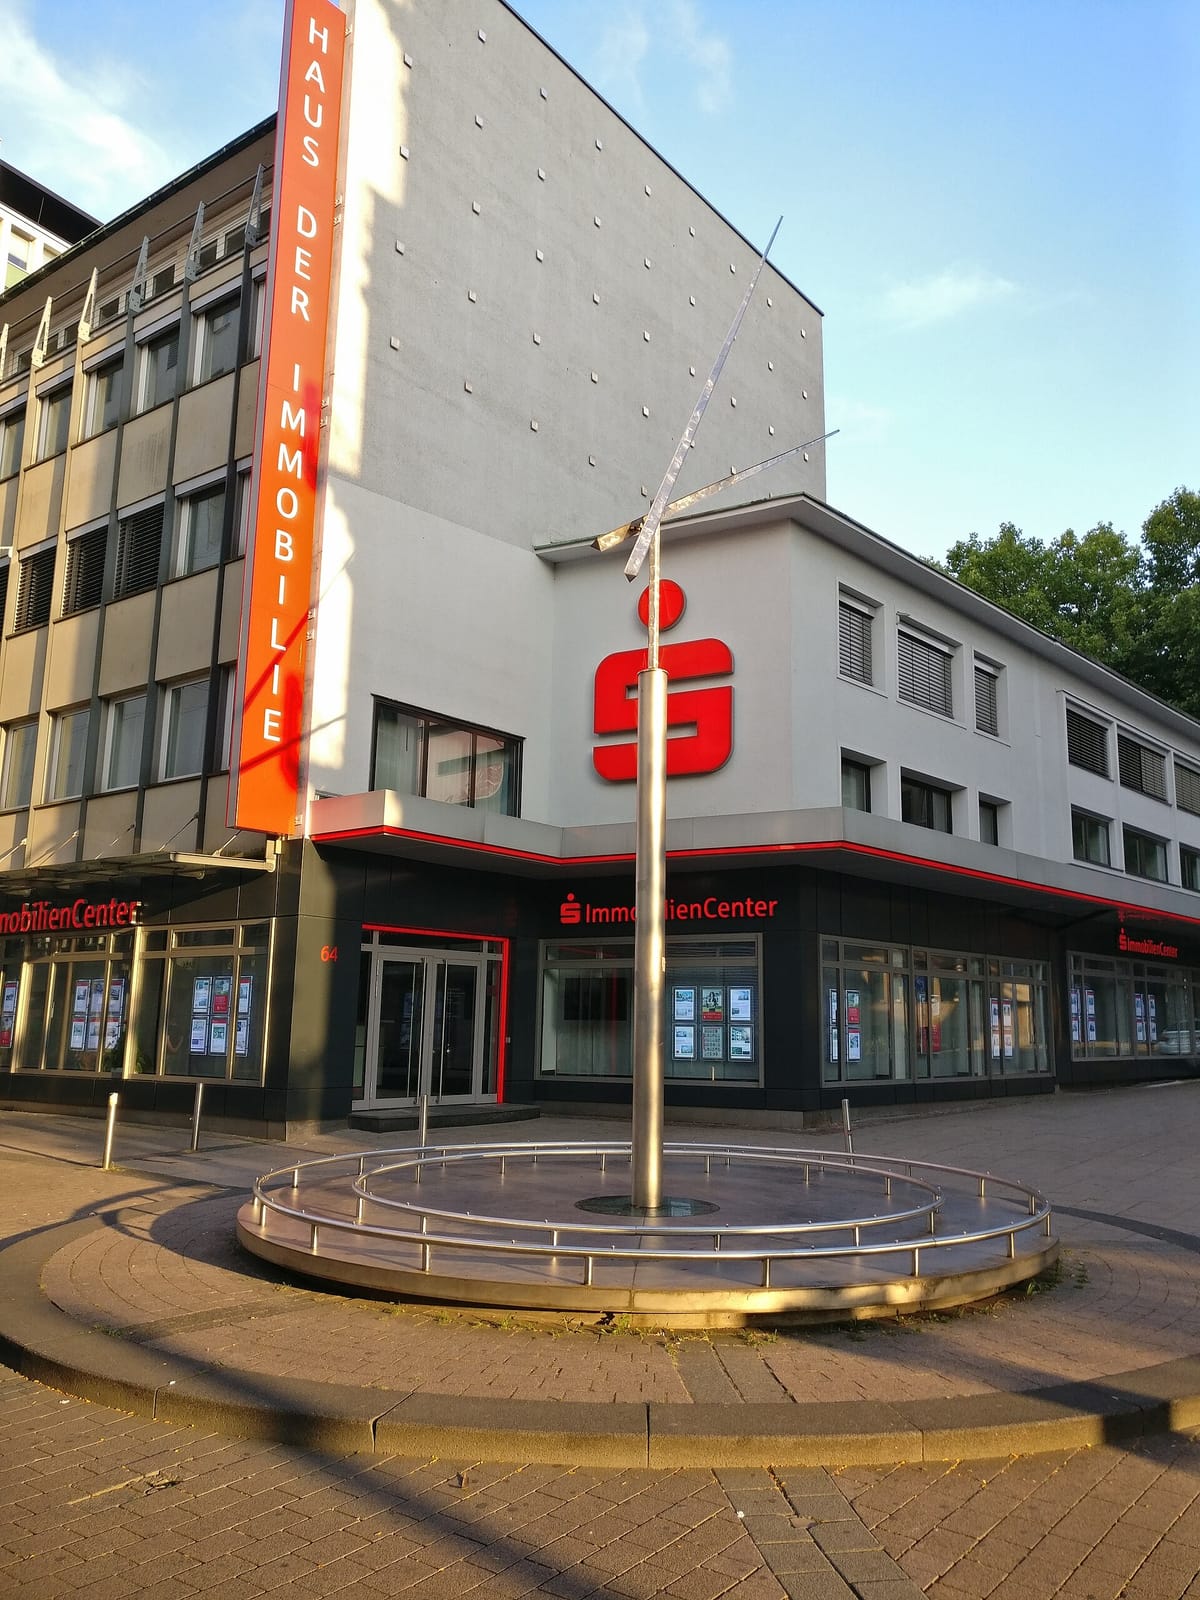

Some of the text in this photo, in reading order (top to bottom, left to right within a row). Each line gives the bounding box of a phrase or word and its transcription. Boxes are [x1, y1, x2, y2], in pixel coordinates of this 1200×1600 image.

[263, 17, 329, 743] HAUS DER IMMOBILIE
[320, 945, 338, 962] 64
